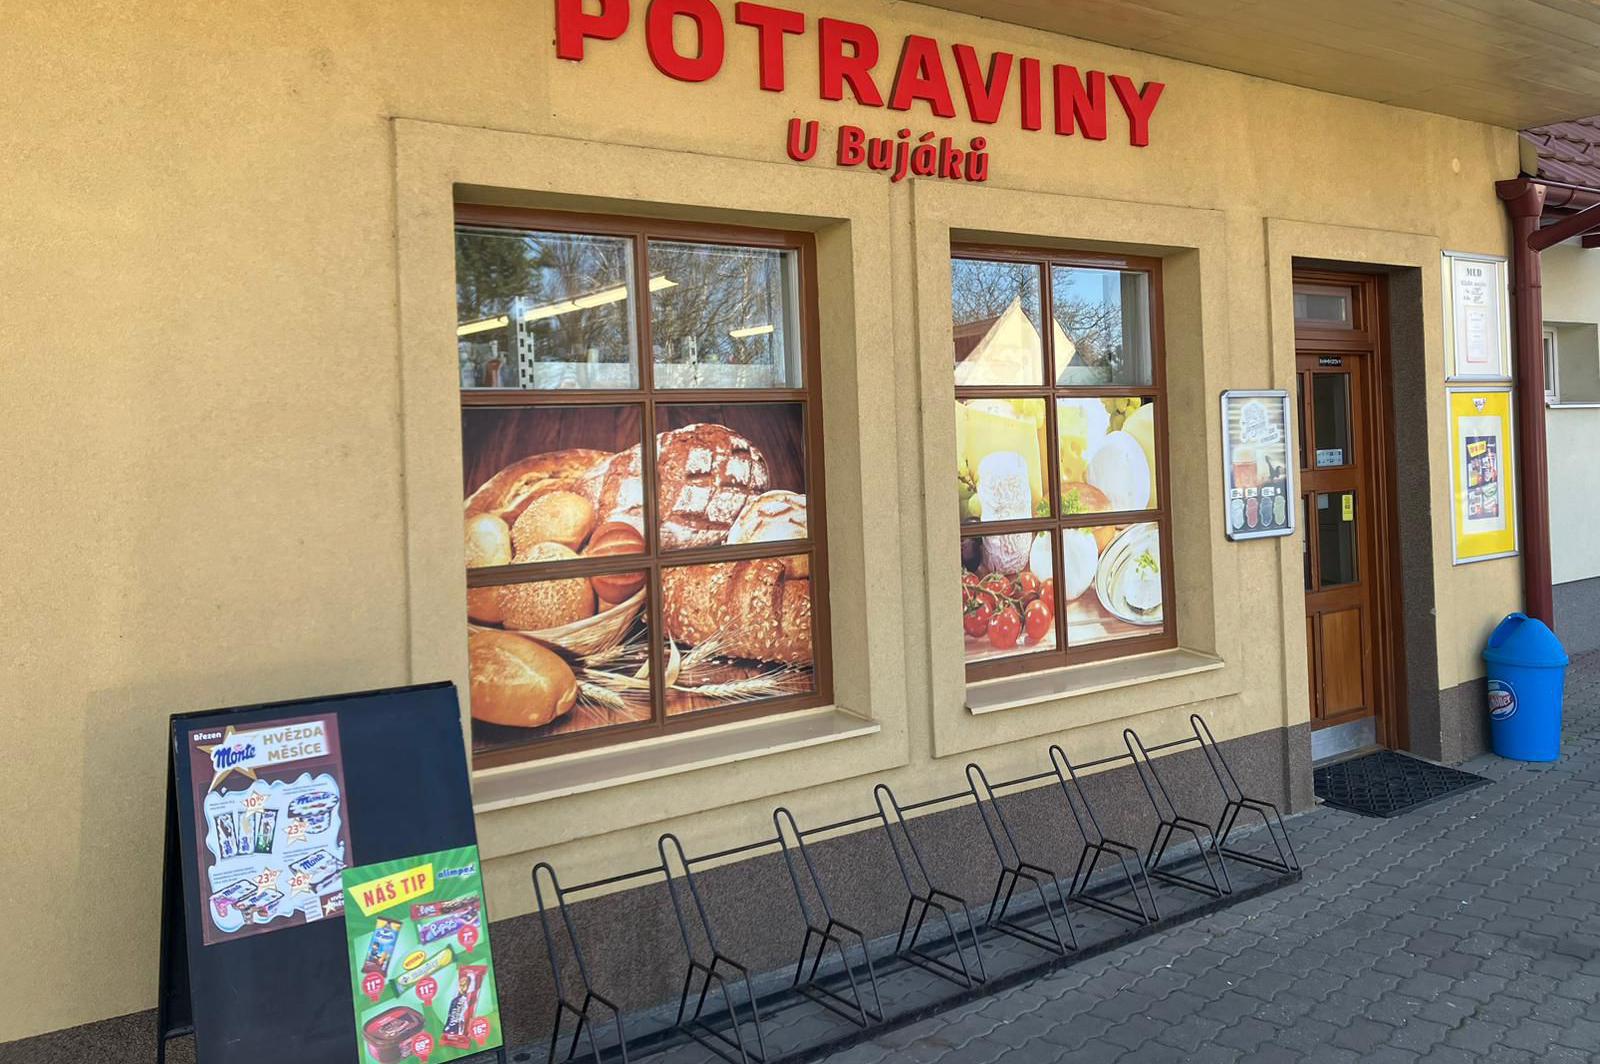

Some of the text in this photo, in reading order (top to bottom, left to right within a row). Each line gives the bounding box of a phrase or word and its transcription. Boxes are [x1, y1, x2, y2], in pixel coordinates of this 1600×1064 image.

[555, 0, 1166, 148] POTRAVINY
[787, 117, 990, 184] U Bujáků
[193, 731, 222, 742] Březen
[262, 724, 323, 746] HVĚZDA
[213, 743, 257, 769] Monte
[267, 741, 322, 762] MĚSÍCE
[363, 873, 427, 908] NÁŠ TIP
